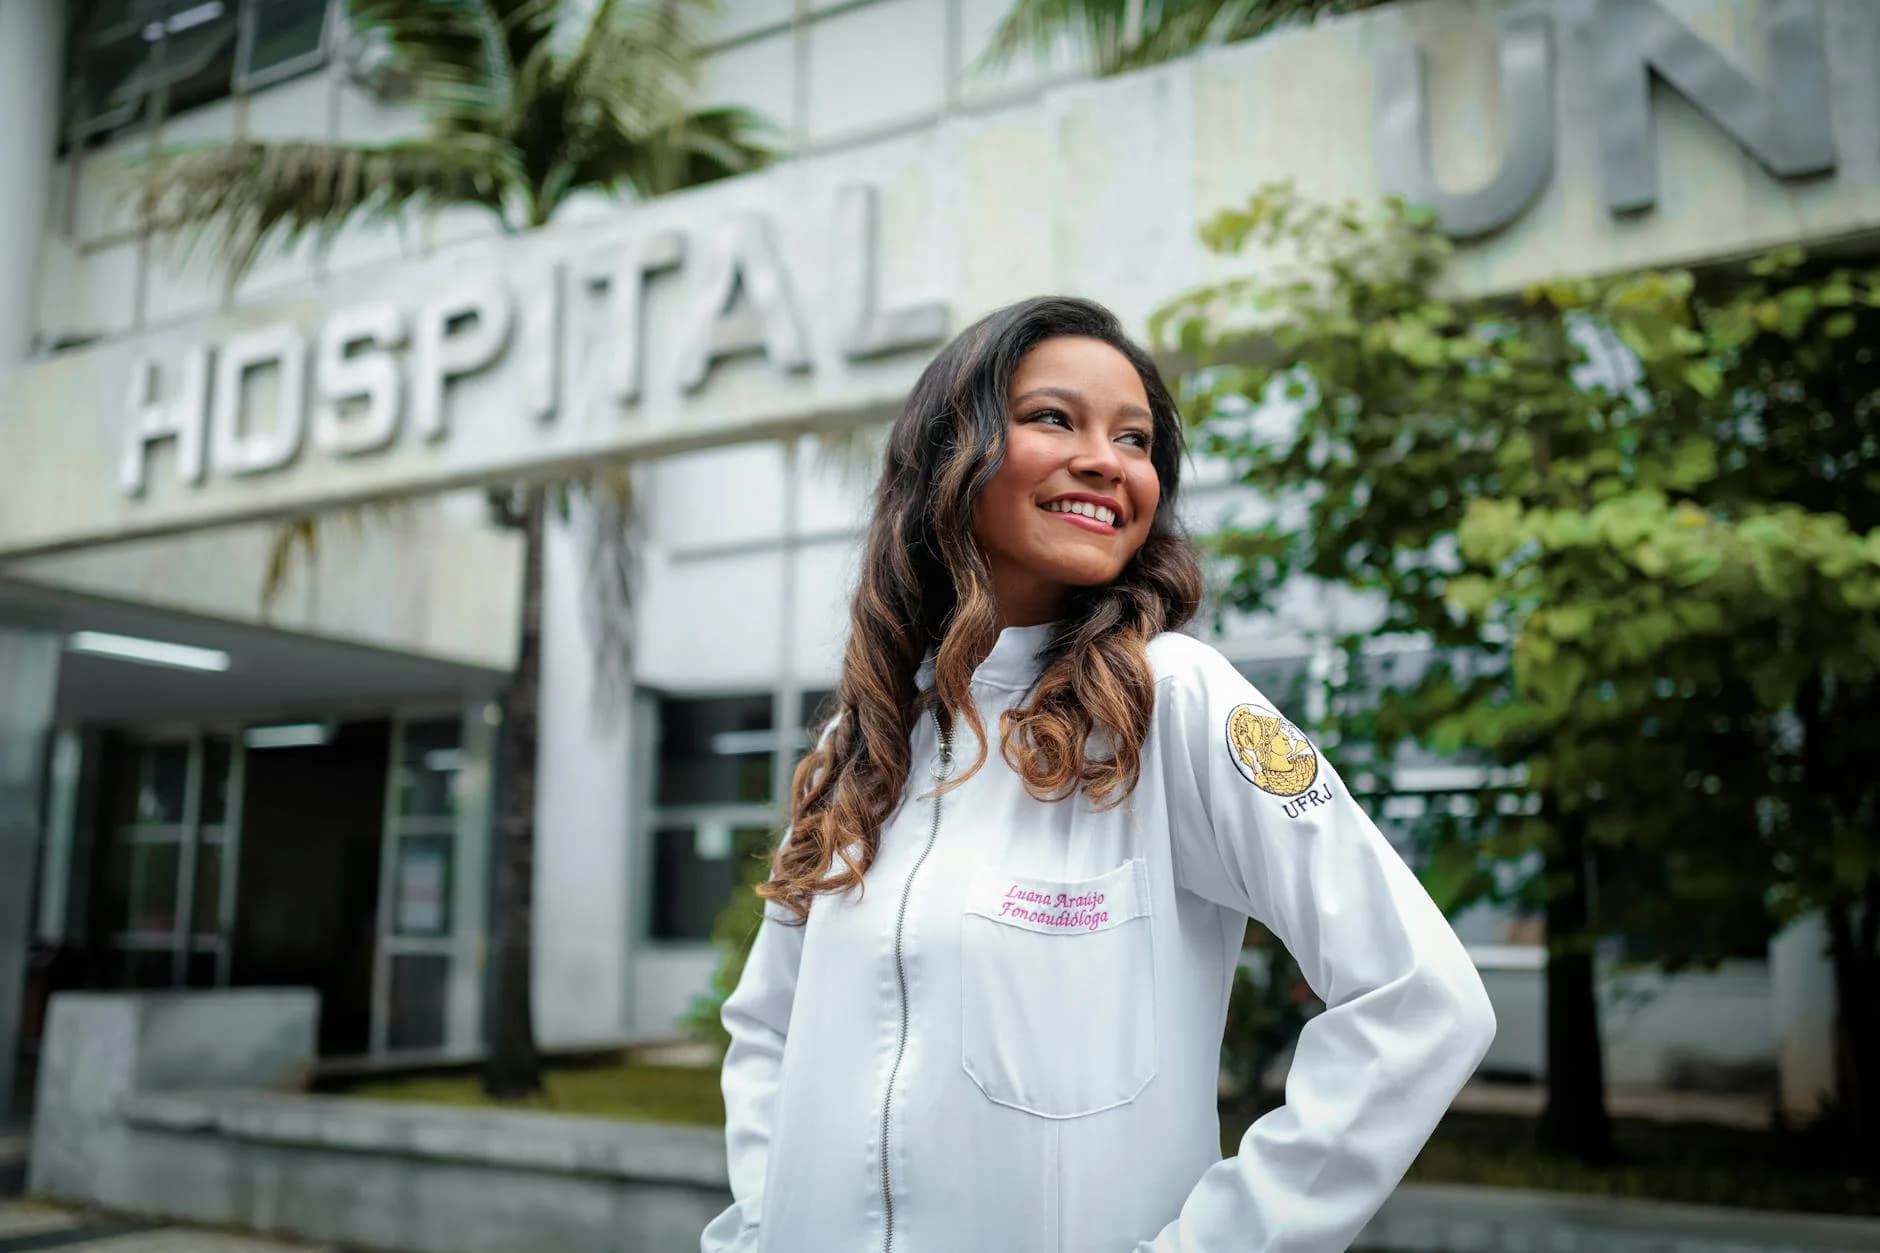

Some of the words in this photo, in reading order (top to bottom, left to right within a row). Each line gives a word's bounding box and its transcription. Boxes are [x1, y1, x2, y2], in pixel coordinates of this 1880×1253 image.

[119, 181, 951, 499] HOSPITAL
[1282, 783, 1333, 819] UFRJ
[1004, 885, 1051, 905] Luana
[1053, 890, 1105, 910] Araújo
[998, 902, 1109, 931] Fonoaudióloga
